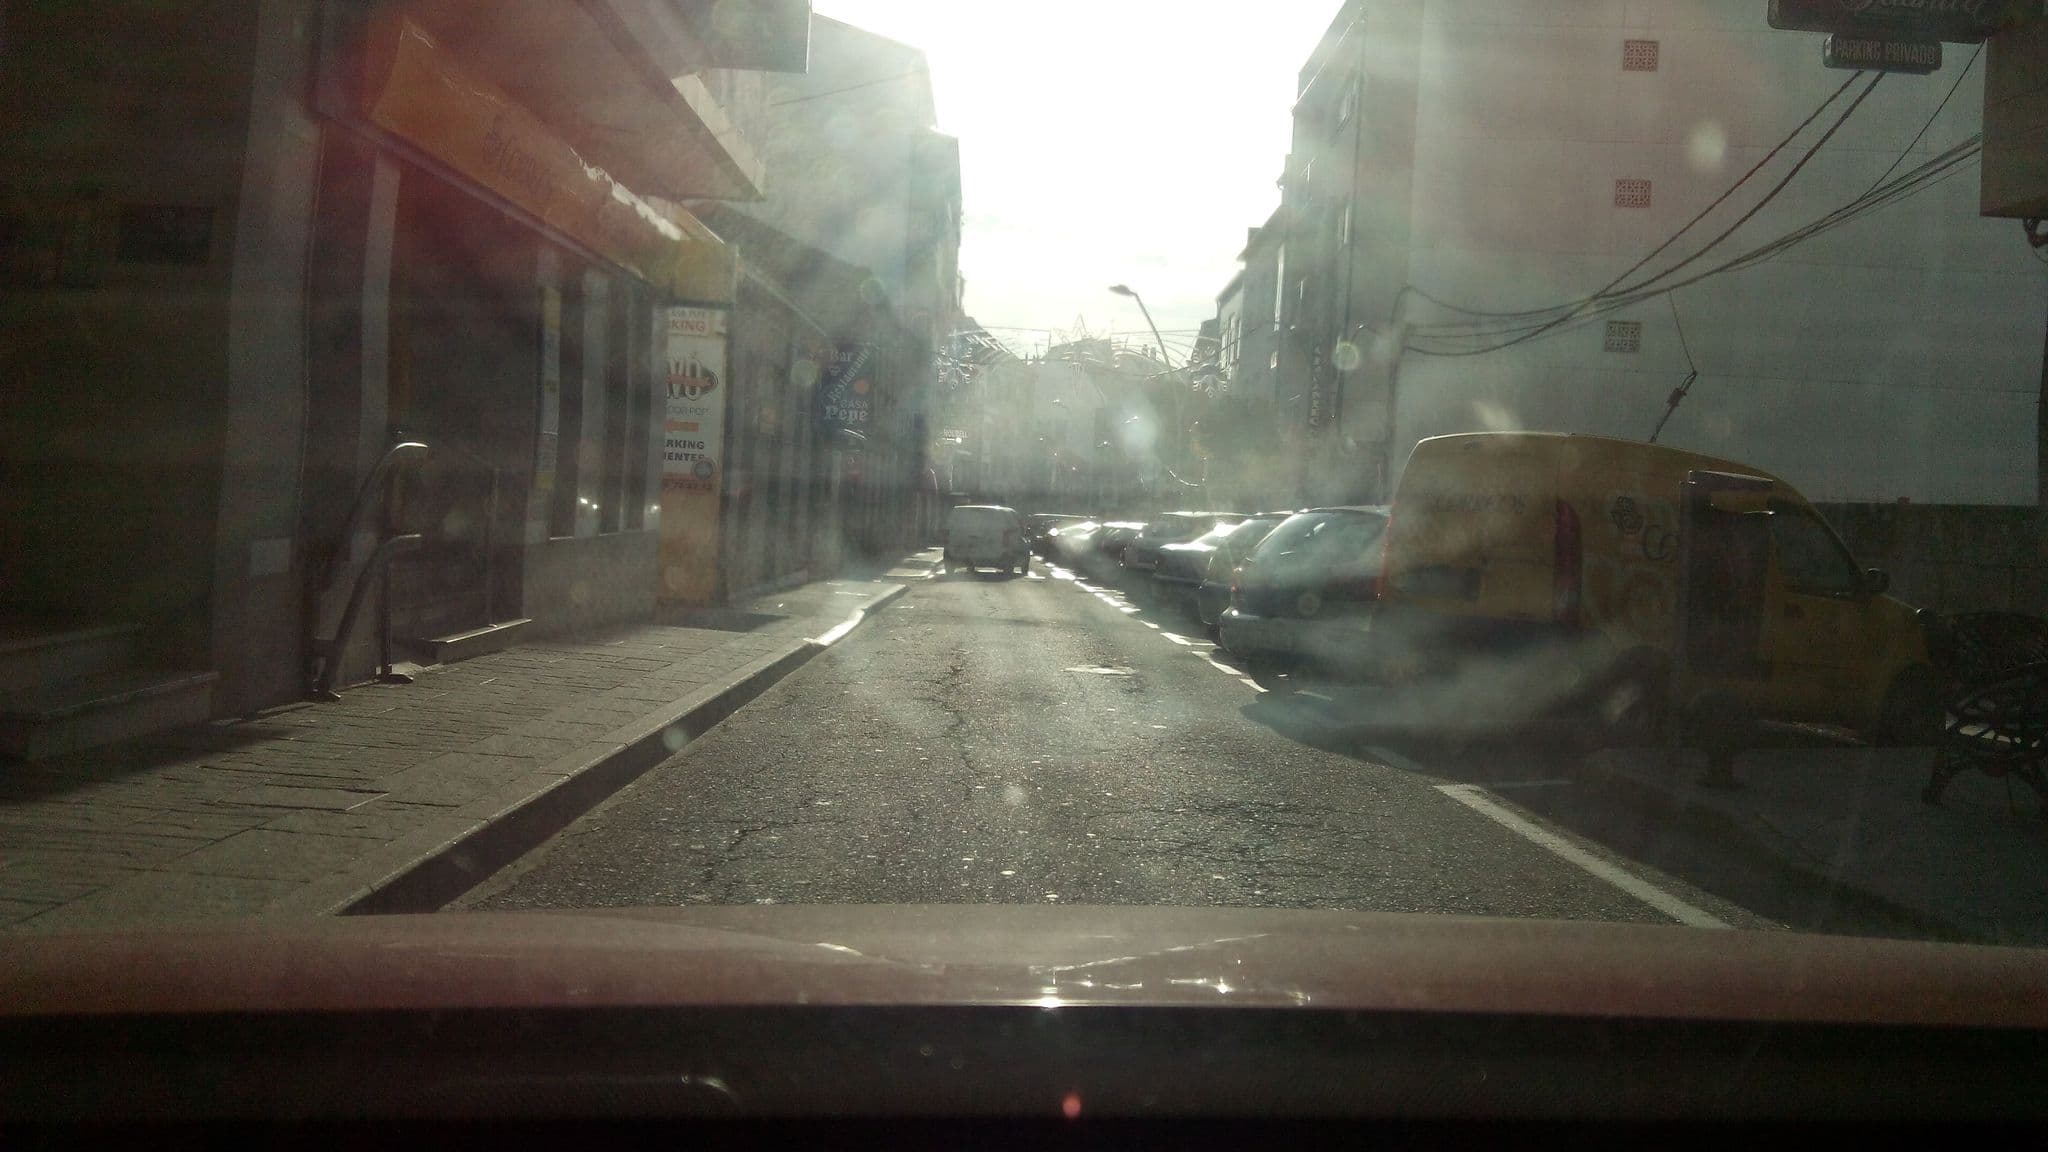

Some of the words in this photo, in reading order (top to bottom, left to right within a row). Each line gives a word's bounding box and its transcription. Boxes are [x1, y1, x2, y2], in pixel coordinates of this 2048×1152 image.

[1834, 38, 1881, 62] PARKING
[1884, 40, 1936, 65] PRIVADO
[828, 351, 852, 363] Bar
[824, 404, 869, 425] Pepe
